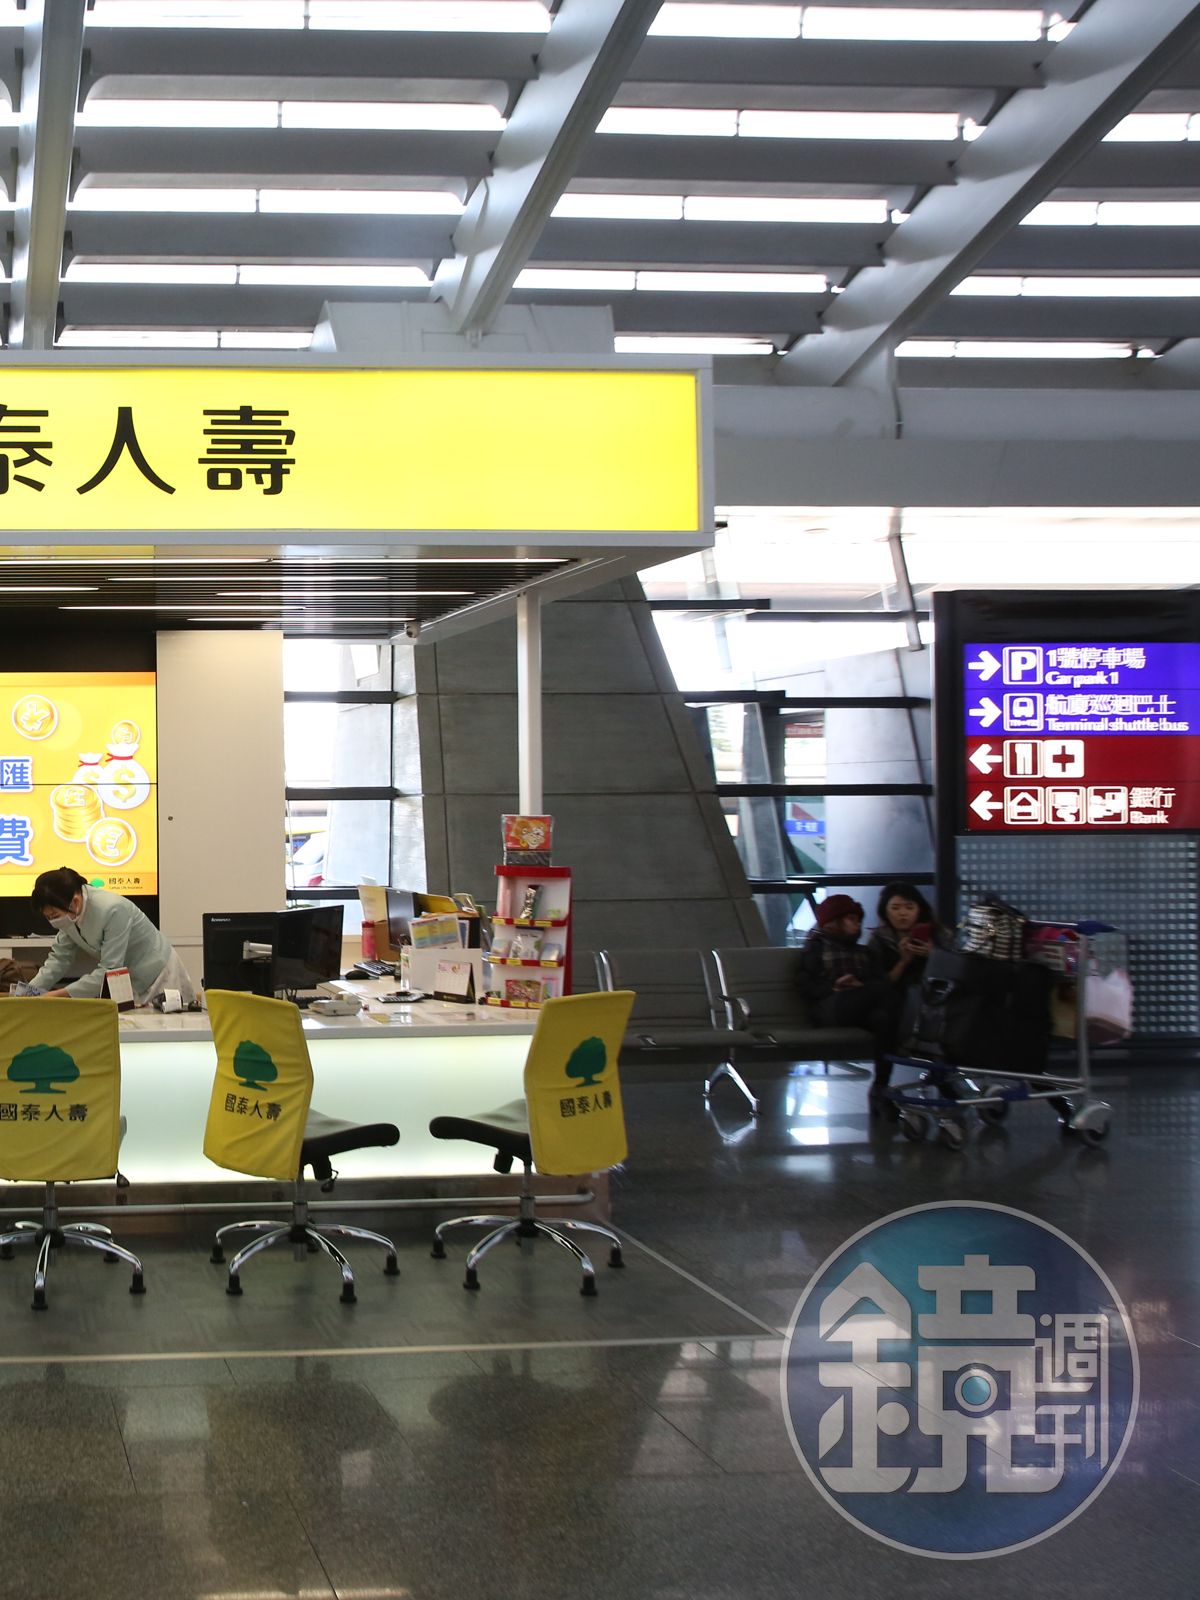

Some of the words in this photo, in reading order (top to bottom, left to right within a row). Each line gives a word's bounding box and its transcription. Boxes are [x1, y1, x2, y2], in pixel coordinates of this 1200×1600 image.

[1045, 718, 1108, 731] Terminal
[1108, 717, 1159, 731] shuttle
[1159, 717, 1189, 731] bus
[1129, 787, 1176, 808] 銀行
[1129, 811, 1169, 824] Bank
[225, 1093, 281, 1121] 國泰人壽
